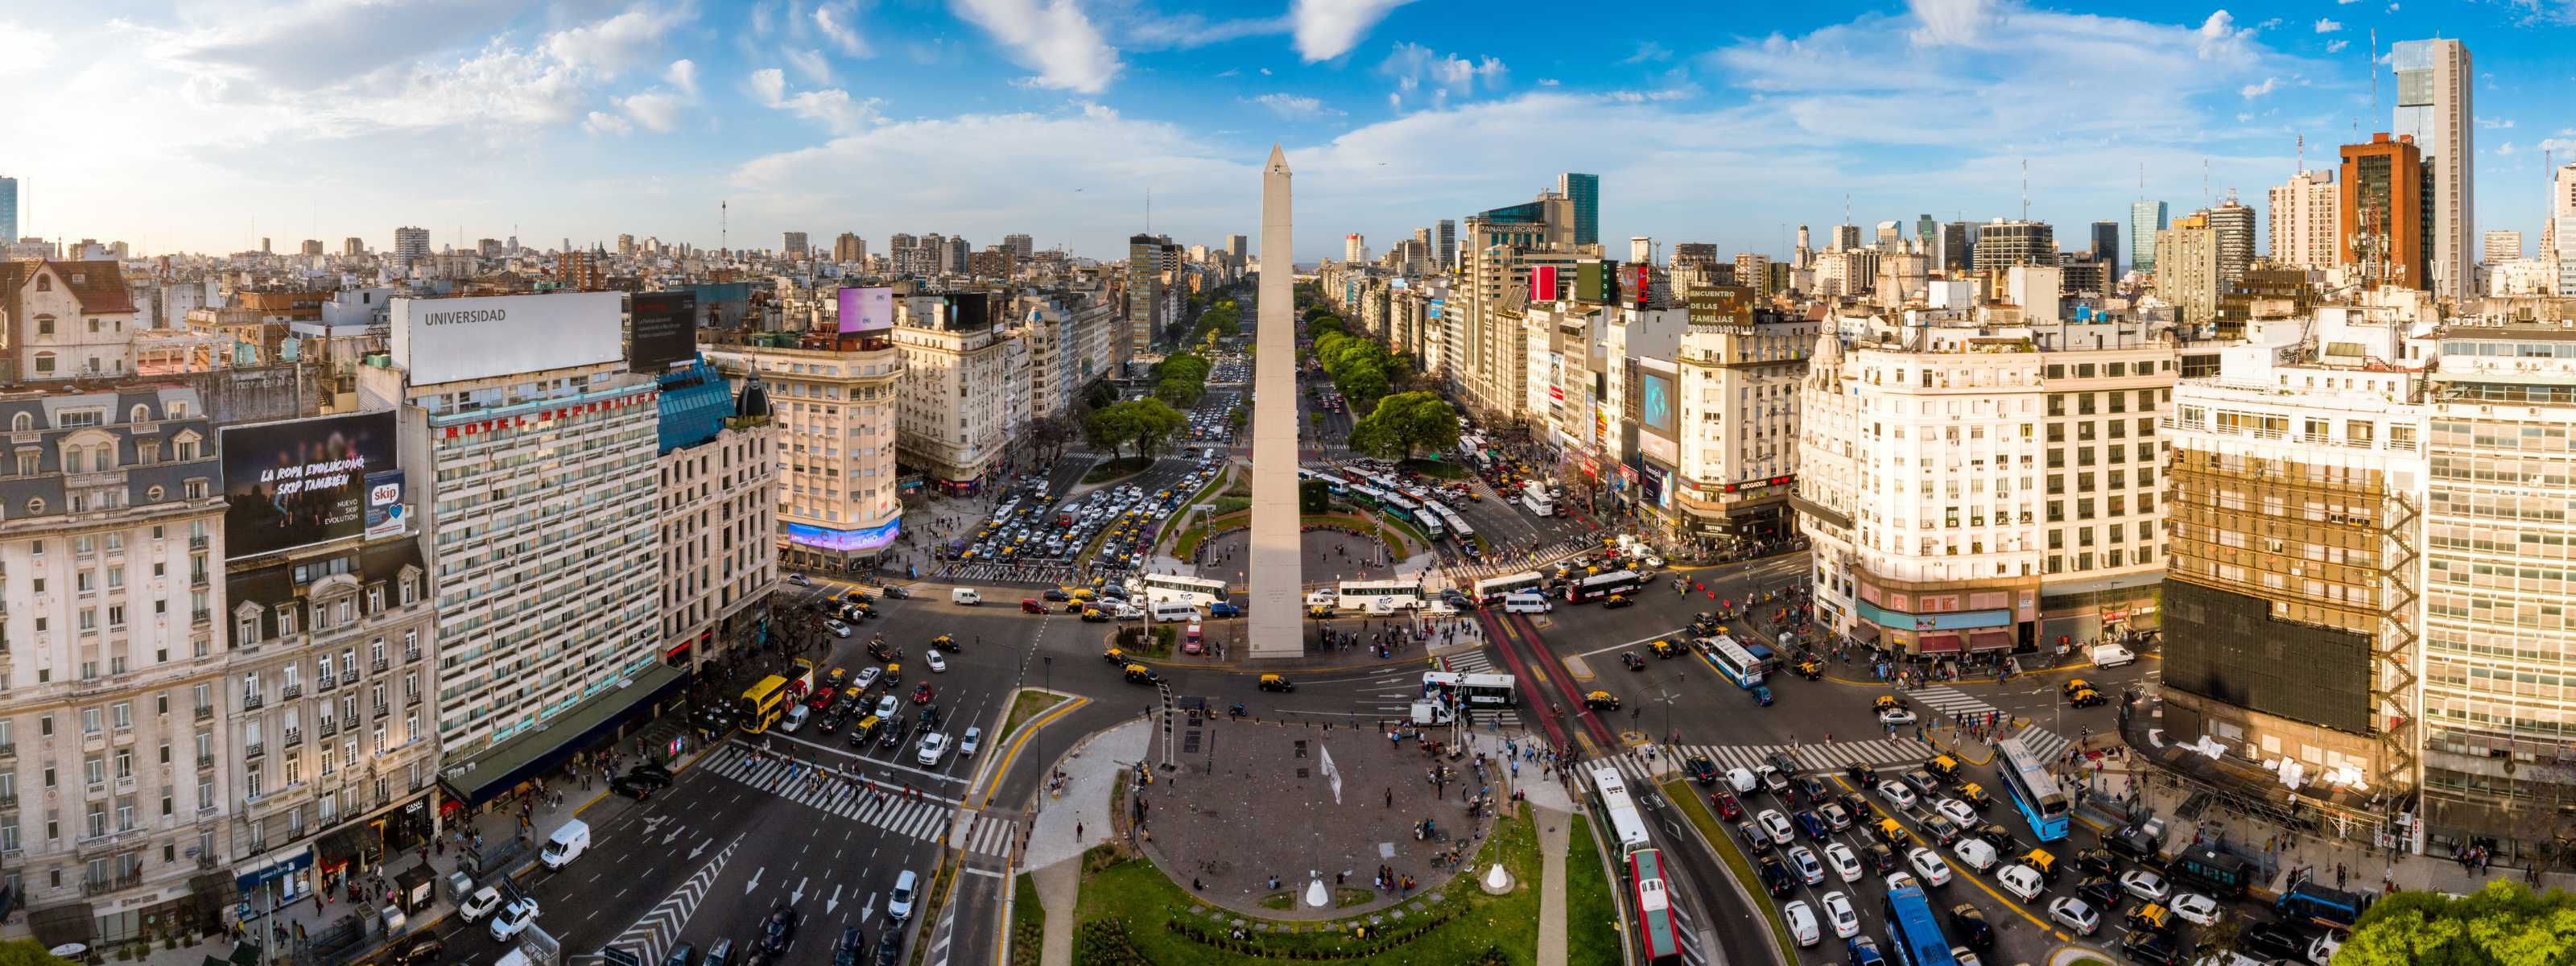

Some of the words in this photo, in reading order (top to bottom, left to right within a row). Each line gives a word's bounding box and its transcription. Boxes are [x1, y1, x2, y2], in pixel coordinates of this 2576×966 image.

[425, 309, 506, 326] UNIVERSIDAD
[1690, 315, 1734, 323] FAMILIAS
[447, 414, 526, 439] HOTEL
[261, 469, 274, 482] LA
[277, 465, 303, 481] ROPA
[278, 480, 303, 495] SKIP
[305, 474, 349, 492] TAMBIÉN
[1740, 481, 1767, 490] ABOGADOS
[374, 488, 396, 501] skip
[337, 498, 358, 509] NUEVO
[324, 514, 358, 525] EVOLUTION
